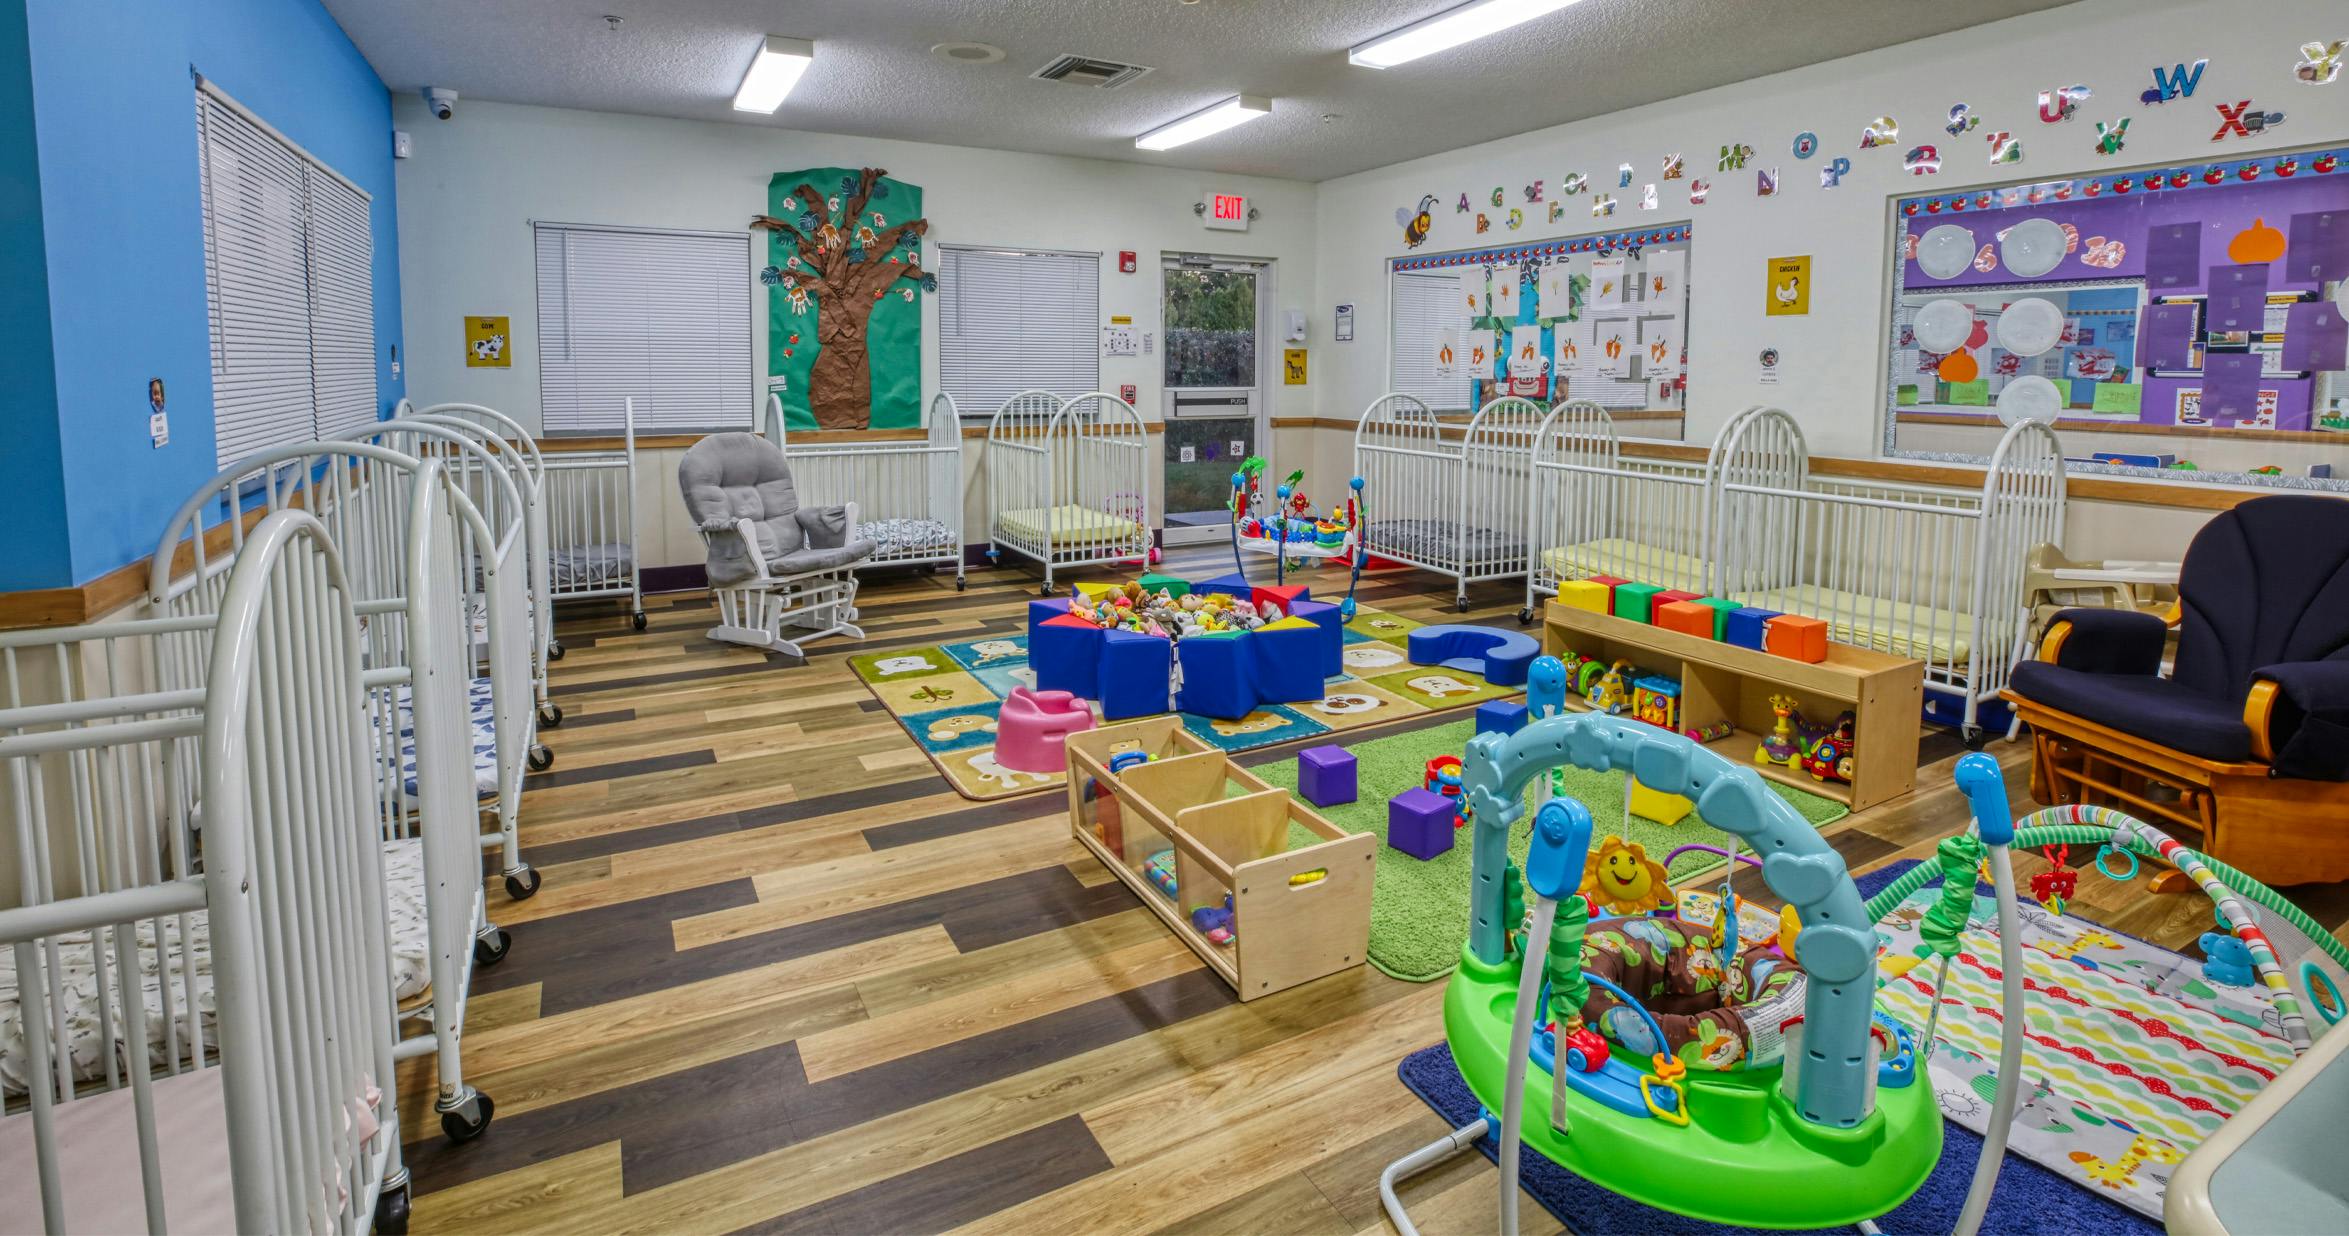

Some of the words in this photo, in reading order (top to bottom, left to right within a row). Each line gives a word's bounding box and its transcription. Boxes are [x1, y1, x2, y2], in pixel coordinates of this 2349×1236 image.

[1459, 192, 1470, 213] A
[1476, 213, 1487, 234] B
[1508, 208, 1523, 231] D
[1533, 180, 1543, 202] E
[1548, 200, 1560, 224] F
[1718, 143, 1744, 172] M
[1757, 168, 1778, 197] N
[1792, 131, 1818, 160] O
[1832, 157, 1850, 186] P
[1914, 145, 1938, 176] R
[1948, 103, 1969, 135] S
[2038, 87, 2069, 124] U
[2095, 118, 2131, 155] V
[2152, 60, 2208, 101] W
[2210, 99, 2252, 141] X
[2302, 40, 2346, 82] Y
[1215, 195, 1243, 220] EXIT
[1779, 264, 1801, 273] CHICKEN
